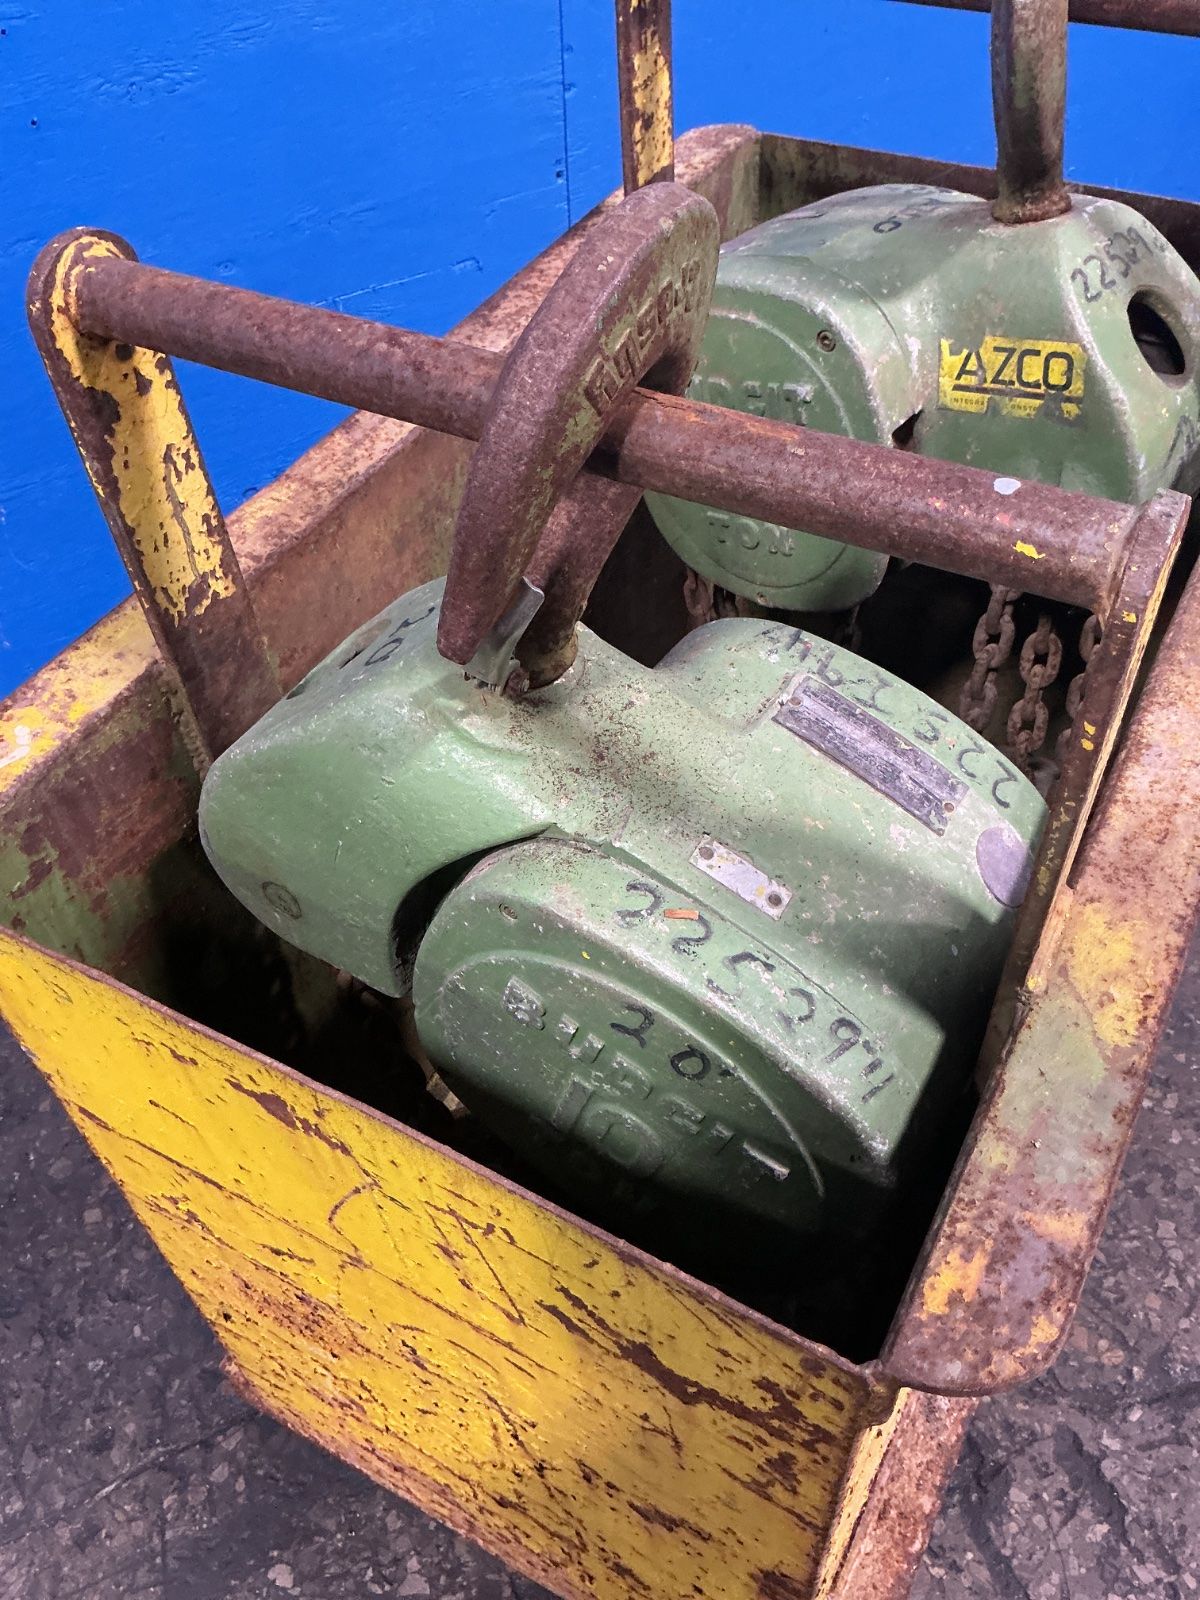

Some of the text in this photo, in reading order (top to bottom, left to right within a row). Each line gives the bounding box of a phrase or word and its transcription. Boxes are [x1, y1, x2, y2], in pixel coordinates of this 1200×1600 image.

[954, 346, 1075, 392] AZCO
[502, 974, 791, 1188] BUDGIT
[614, 880, 895, 1103] 225294
